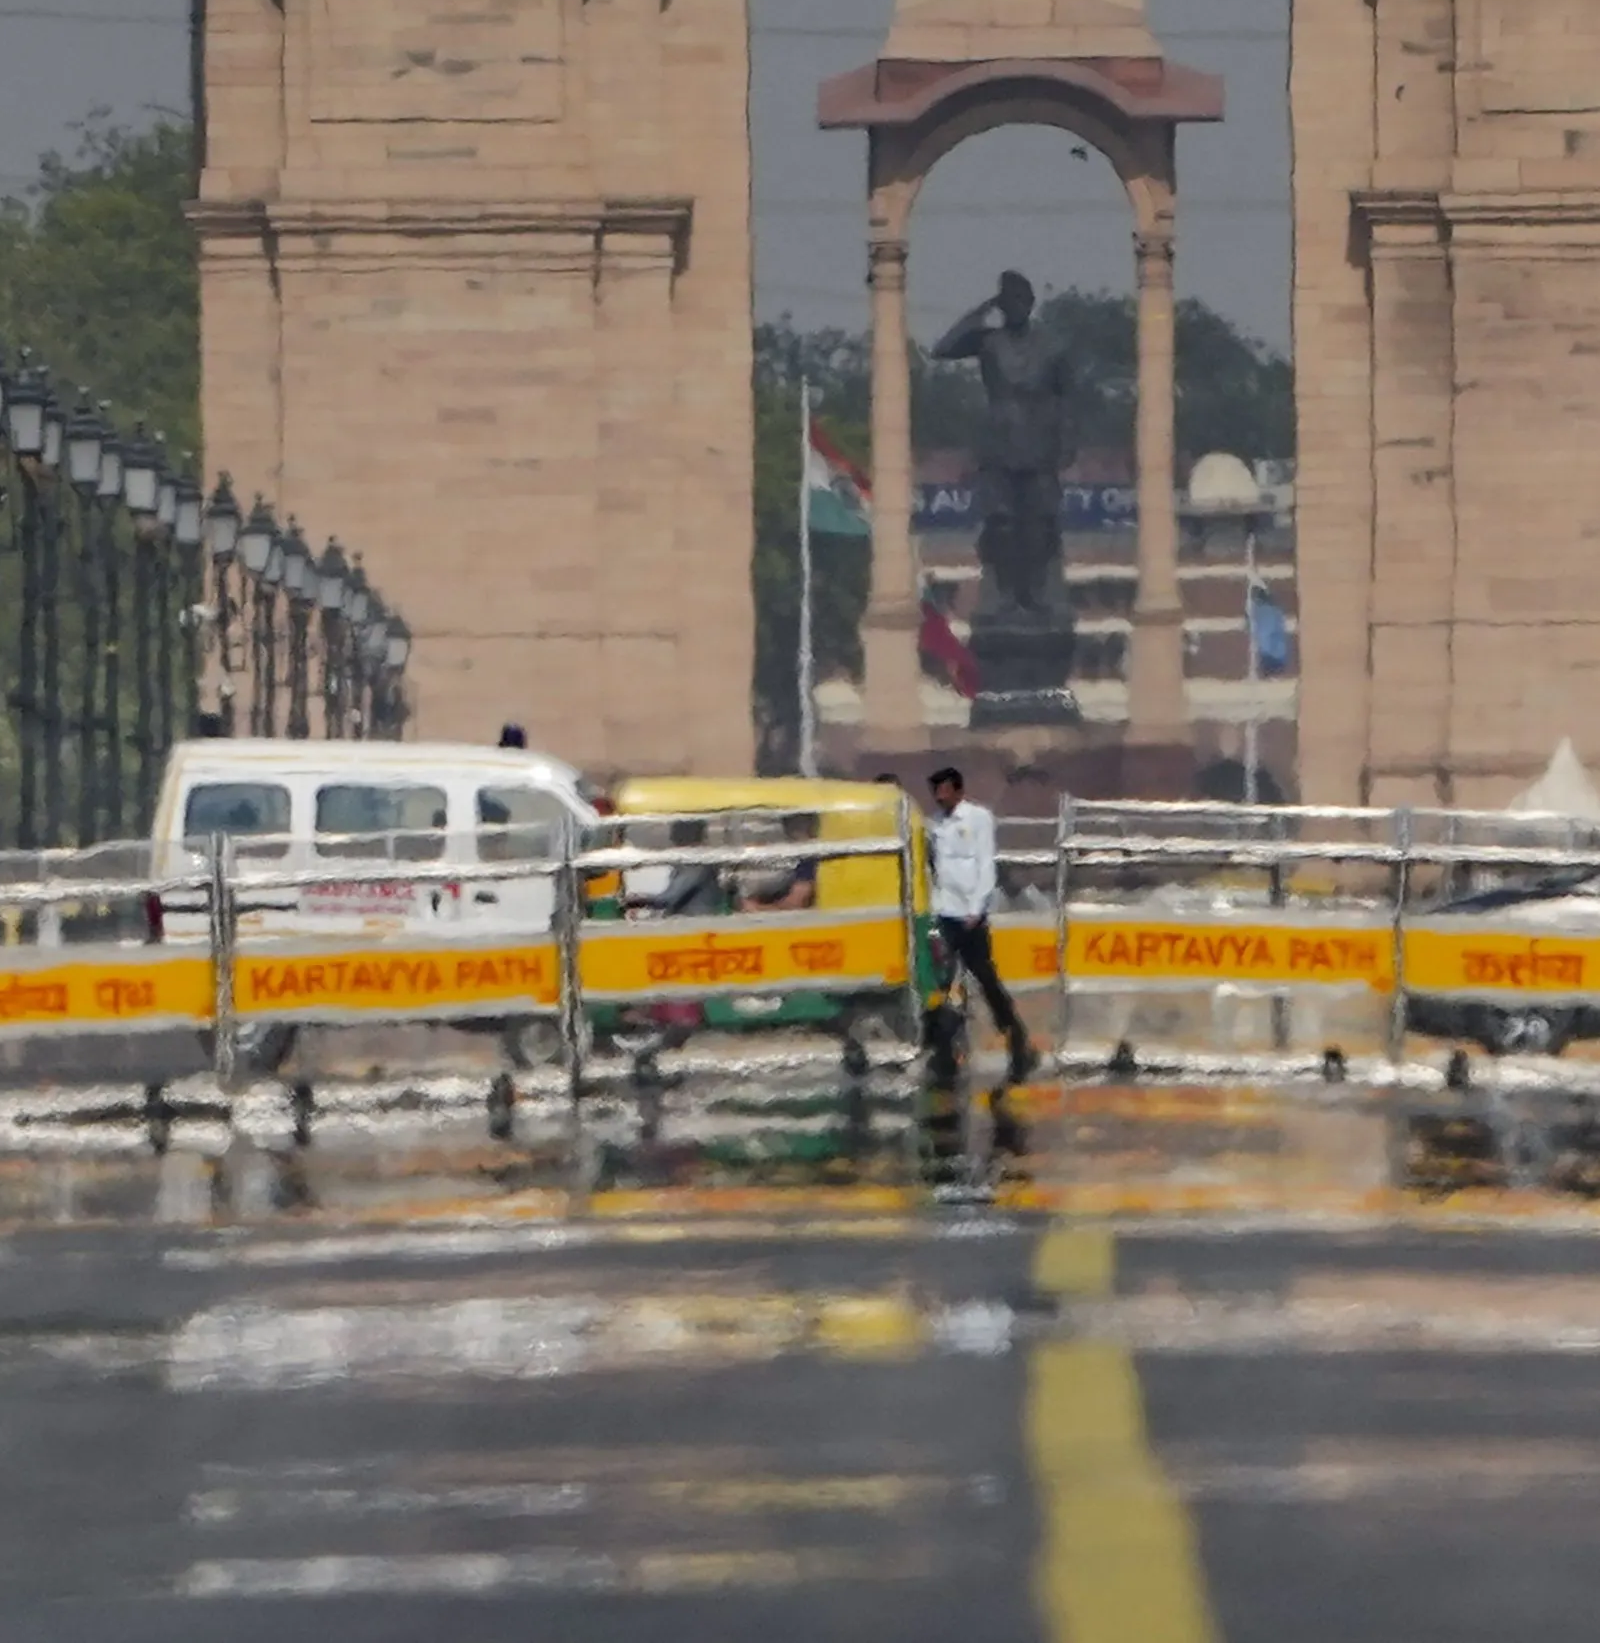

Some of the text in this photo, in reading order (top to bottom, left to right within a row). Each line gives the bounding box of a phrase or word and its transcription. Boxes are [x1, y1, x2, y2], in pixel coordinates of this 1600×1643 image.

[1084, 932, 1275, 968] KARTAVYA
[1288, 937, 1378, 971] PATH
[250, 954, 543, 1001] KARTAVYA PATH
